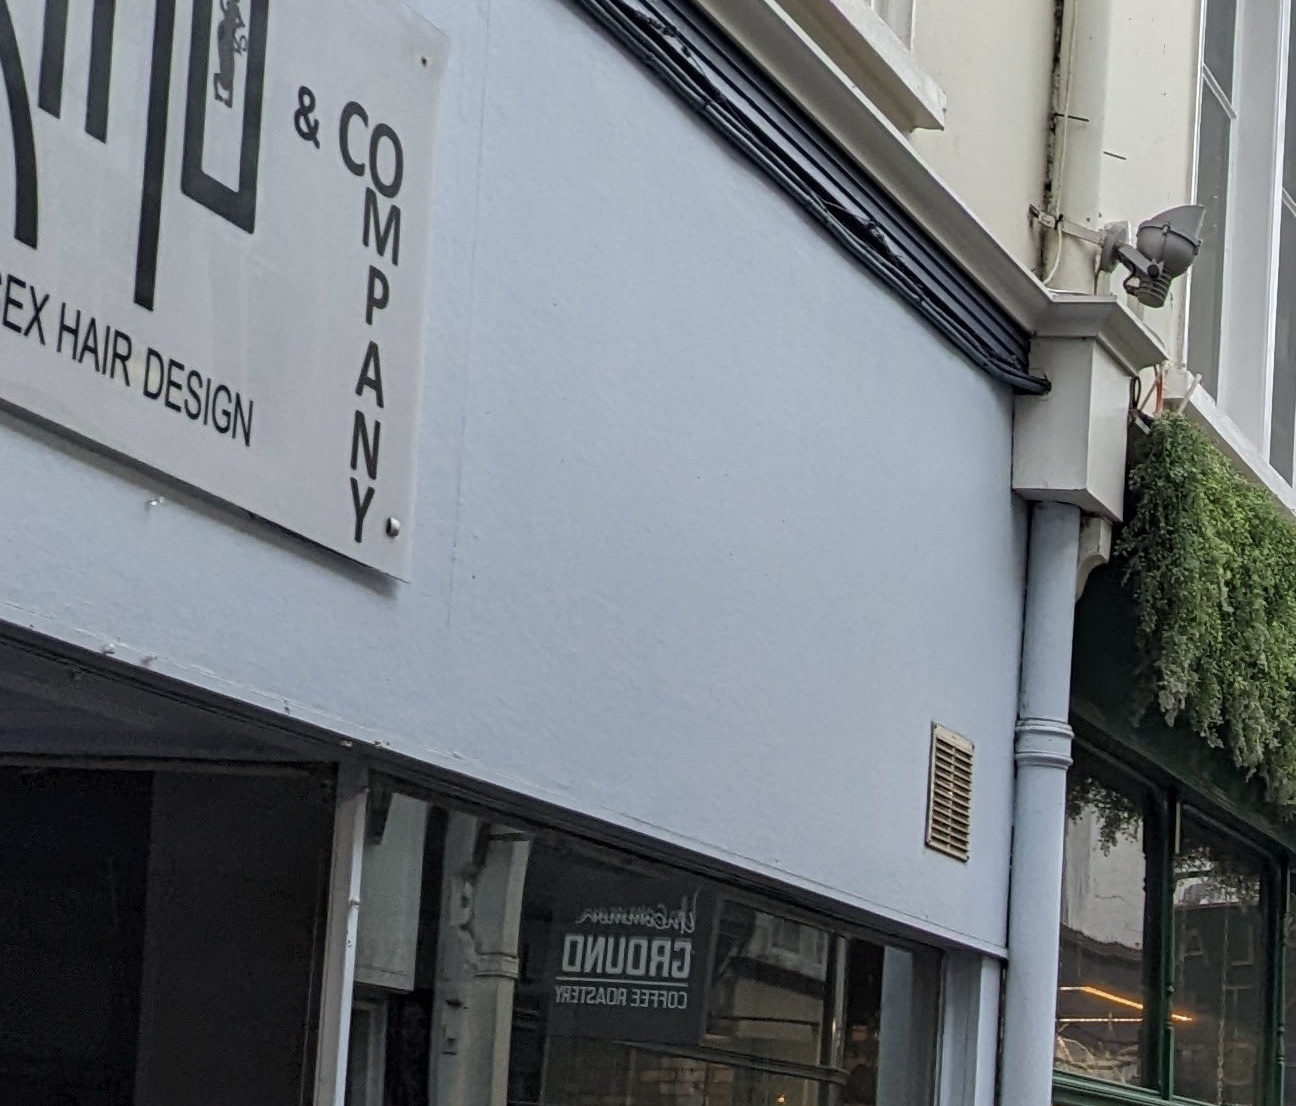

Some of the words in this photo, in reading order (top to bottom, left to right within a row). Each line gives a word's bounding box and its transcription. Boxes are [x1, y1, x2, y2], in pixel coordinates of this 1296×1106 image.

[293, 85, 320, 149] &
[0, 274, 46, 347] EX
[56, 302, 131, 388] HAIR
[142, 347, 255, 447] DESIGN
